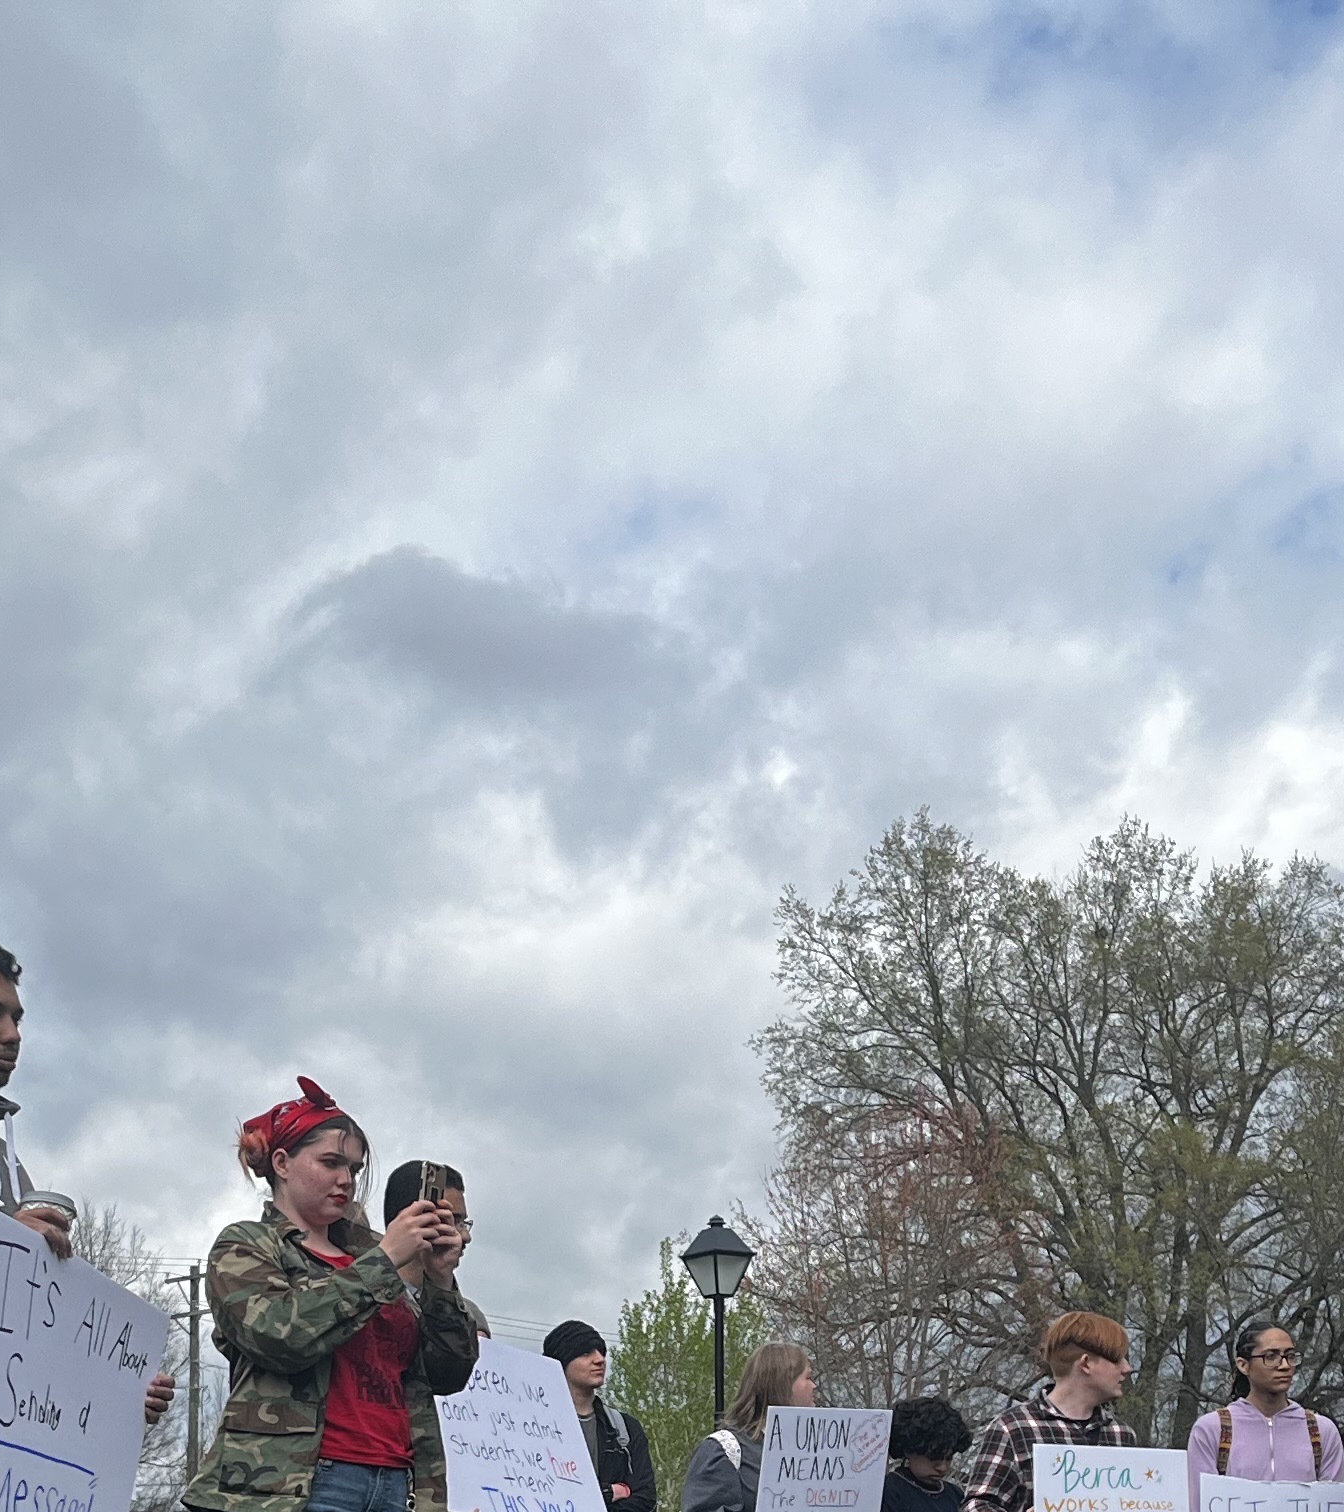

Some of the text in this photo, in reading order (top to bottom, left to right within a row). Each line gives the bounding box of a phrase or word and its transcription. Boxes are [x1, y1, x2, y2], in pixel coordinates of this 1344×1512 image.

[74, 1297, 112, 1357] All
[108, 1321, 149, 1379] About
[441, 1394, 479, 1423] don't
[488, 1409, 516, 1437] just
[769, 1413, 783, 1452] A
[796, 1415, 852, 1454] UNION
[546, 1447, 580, 1479] hire
[1051, 1449, 1143, 1494] Berea
[805, 1487, 861, 1506] DIGNITY
[1119, 1497, 1176, 1512] because
